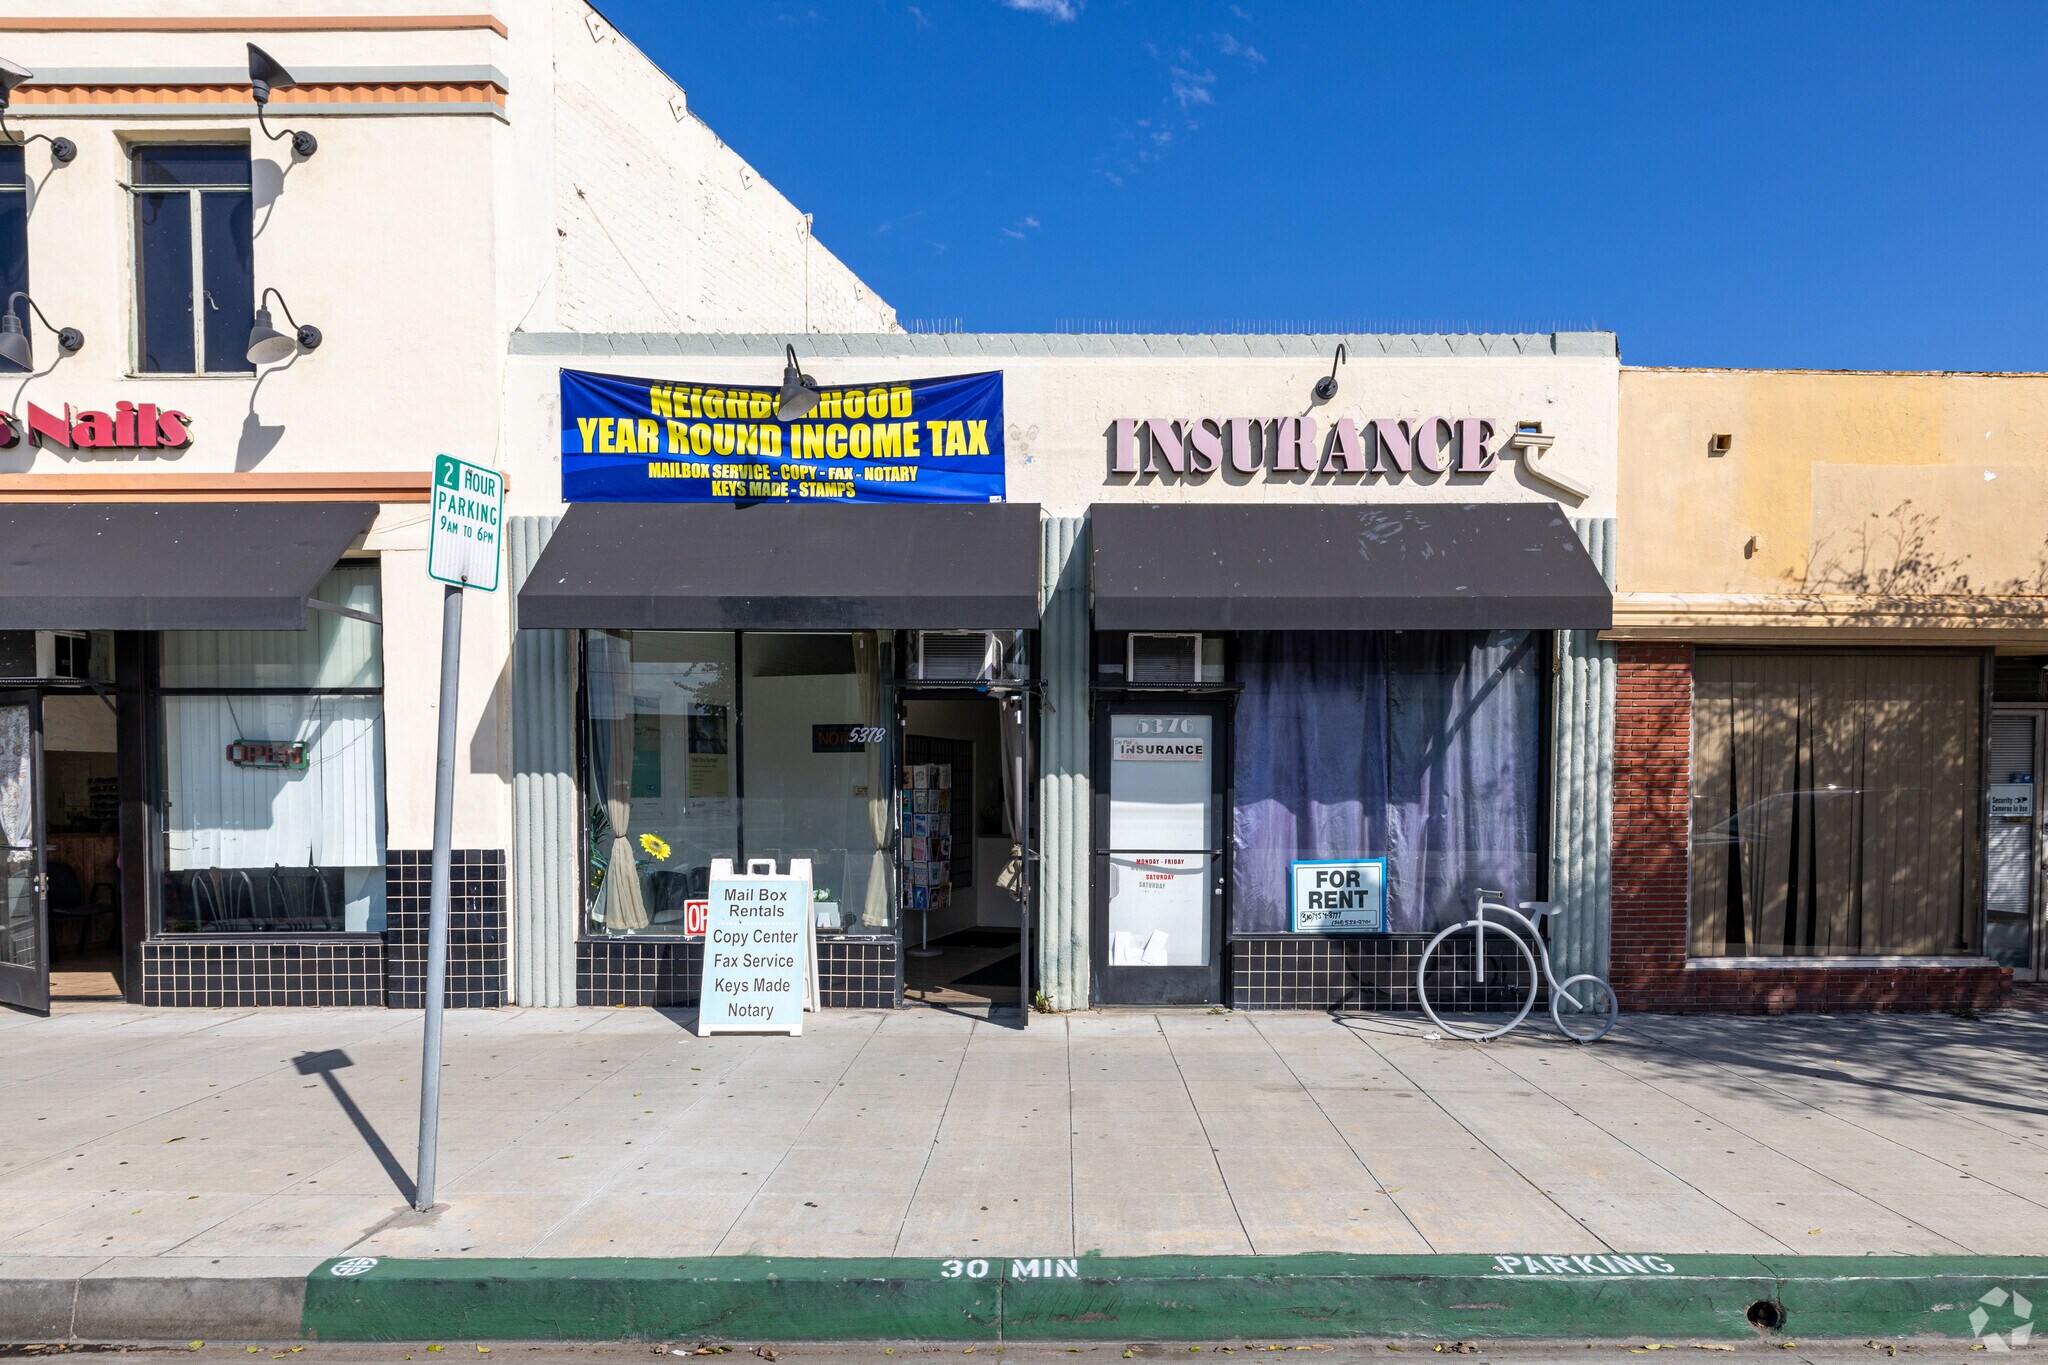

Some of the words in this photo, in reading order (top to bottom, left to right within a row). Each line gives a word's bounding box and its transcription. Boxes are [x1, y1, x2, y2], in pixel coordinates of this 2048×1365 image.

[650, 384, 912, 419] NEIGHBHOOD
[27, 400, 193, 450] Nails
[577, 417, 660, 455] YEAR
[667, 419, 783, 458] ROUND
[790, 420, 921, 460] INCOME
[927, 419, 990, 457] TAX
[1111, 415, 1498, 474] INSURANCE
[443, 461, 454, 486] 2
[464, 469, 496, 498] HOUR
[648, 462, 711, 479] MAILBOX
[712, 463, 771, 481] SERVICE
[780, 464, 818, 480] COPY
[828, 466, 854, 481] FAX
[864, 465, 919, 482] NOTARY
[712, 480, 747, 497] KEYS
[749, 480, 789, 498] MADE
[799, 481, 856, 498] STAMPS
[438, 490, 498, 526] PARKING
[440, 515, 459, 535] 9AM
[463, 524, 473, 538] TO
[476, 526, 494, 545] 6PM
[848, 726, 887, 743] 5378
[1136, 717, 1194, 734] 5376
[226, 744, 303, 765] OPEN
[1120, 745, 1203, 755] INSURANCE
[1316, 870, 1361, 889] FOR
[724, 888, 755, 901] Mail
[760, 888, 788, 901] Box
[1308, 890, 1369, 910] RENT
[688, 903, 709, 933] OP
[729, 904, 785, 917] Rentals
[713, 929, 749, 947] Copy
[753, 929, 799, 943] Center
[714, 953, 739, 968] Fax
[743, 953, 794, 968] Service
[714, 977, 749, 996] Keys
[753, 977, 790, 992] Made
[728, 1002, 775, 1021] Notary
[940, 1259, 989, 1279] 30
[1012, 1258, 1078, 1278] MIN
[1494, 1254, 1676, 1274] PARKING
